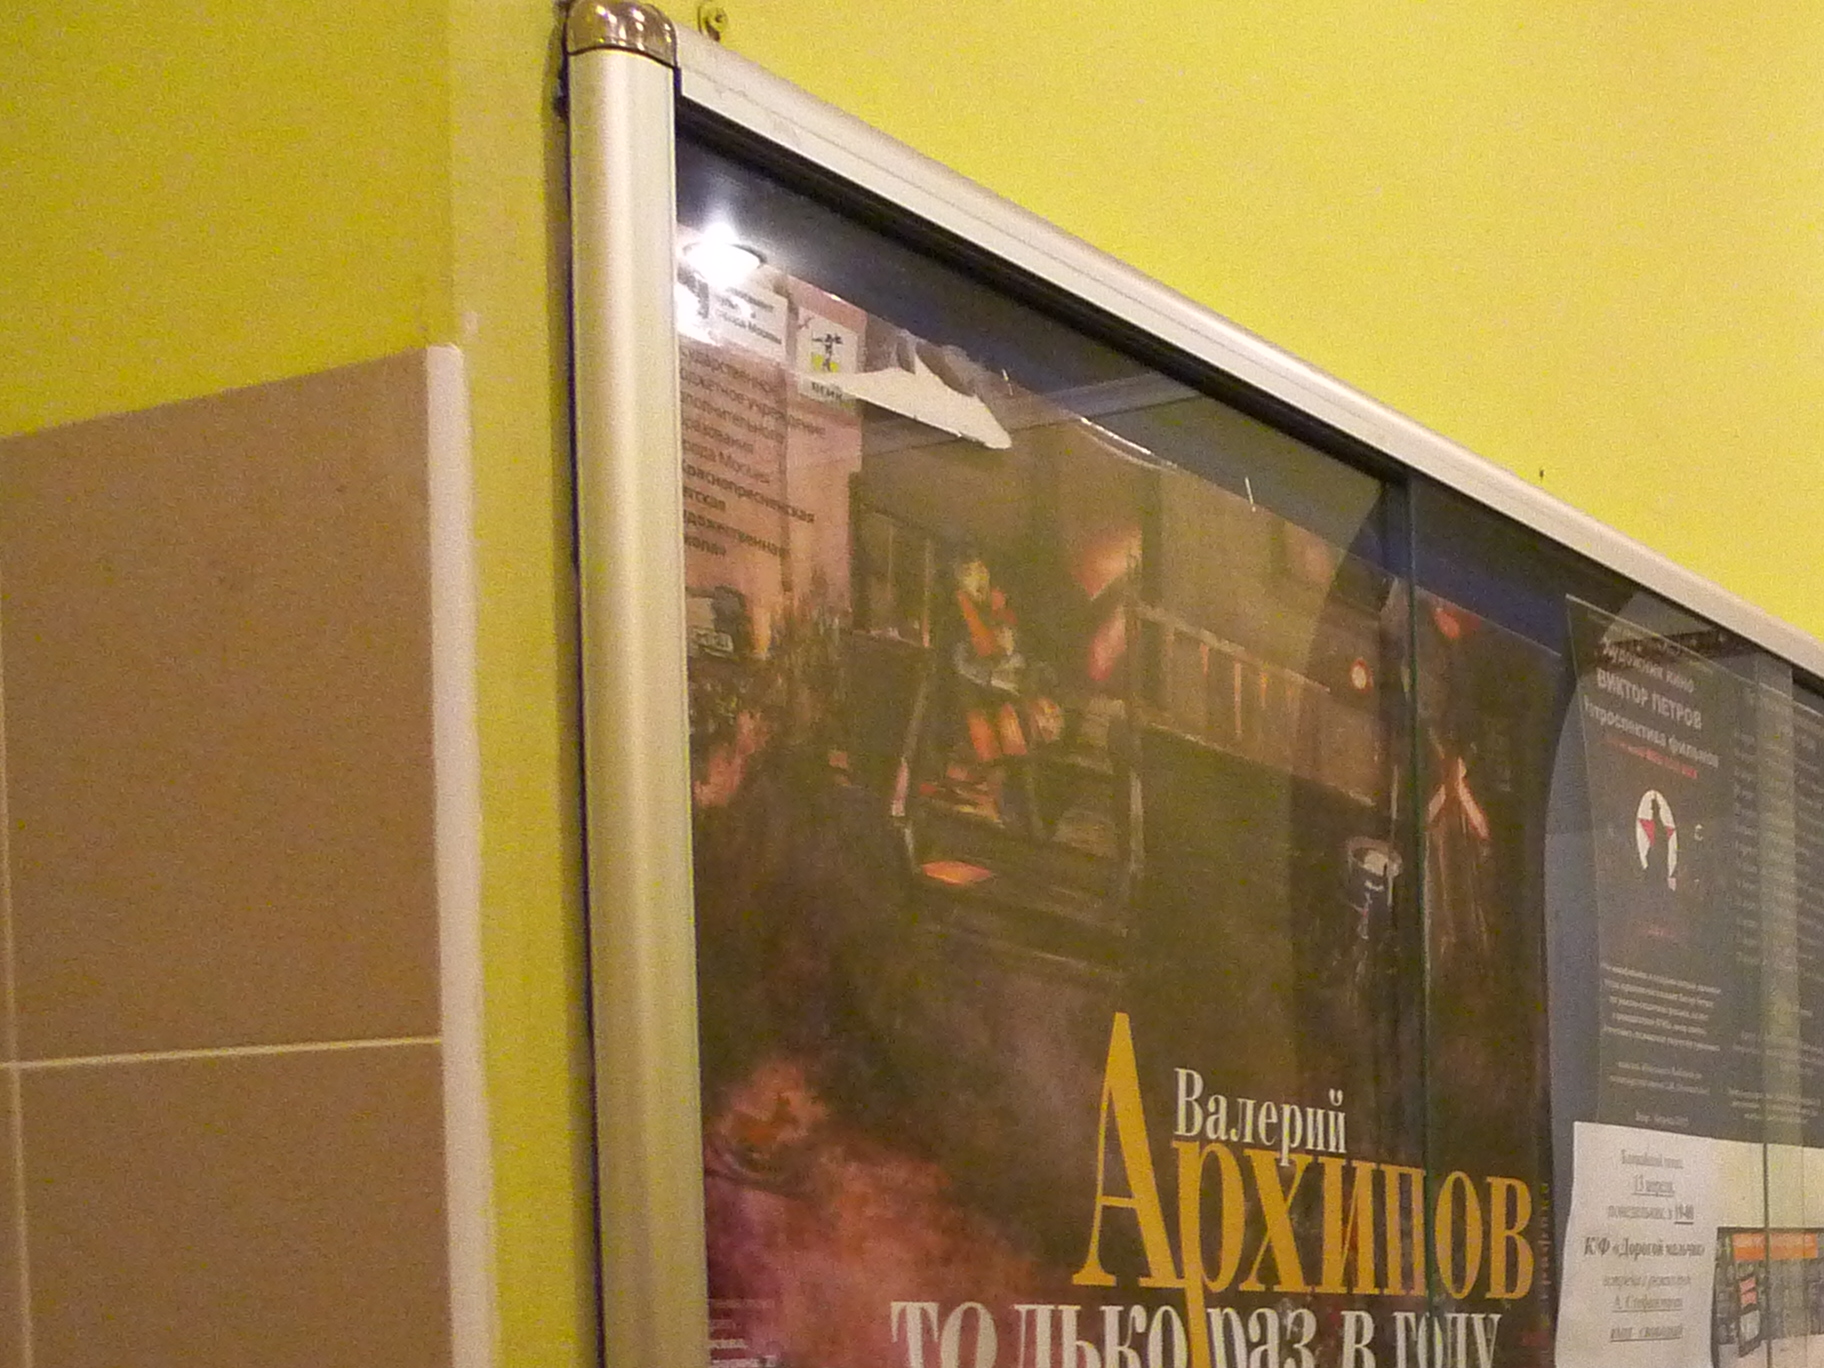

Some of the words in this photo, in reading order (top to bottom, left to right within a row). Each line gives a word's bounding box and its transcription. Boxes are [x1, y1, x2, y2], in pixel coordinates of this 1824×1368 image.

[1597, 667, 1648, 707] ВИКТОР
[1652, 690, 1702, 730] ПЕТРОВ
[1173, 1068, 1348, 1164] Валерий
